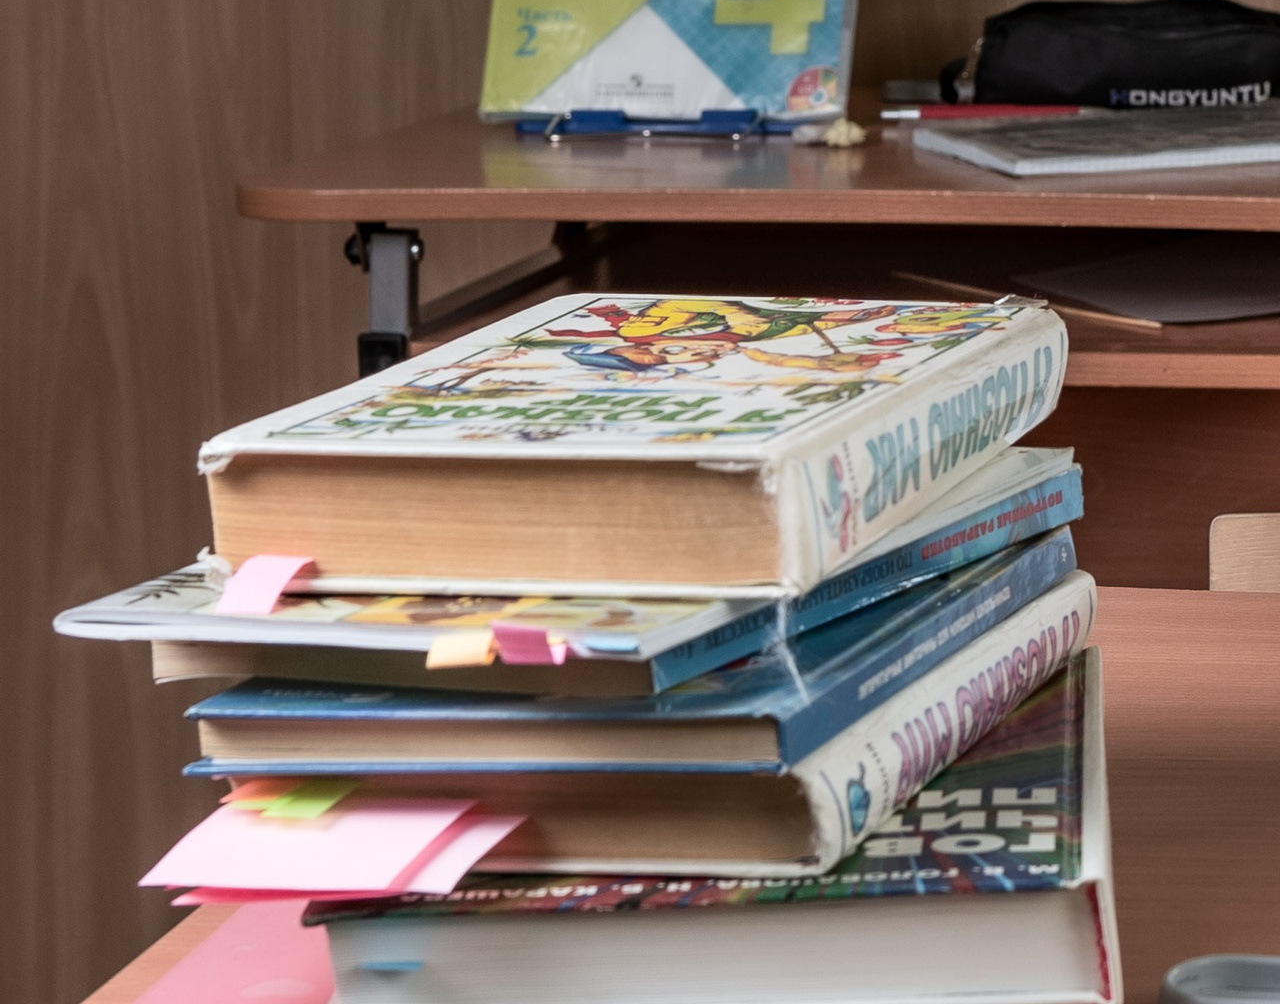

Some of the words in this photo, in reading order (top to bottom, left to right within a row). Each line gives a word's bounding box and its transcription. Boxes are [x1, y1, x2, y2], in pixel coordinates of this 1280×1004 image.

[515, 25, 537, 57] 2
[369, 403, 722, 424] ПОЗНАЮ
[926, 360, 1029, 483] ПОЗНАЮ
[861, 417, 921, 525] МИР
[996, 489, 1063, 530] ПОУРОЧНЫЕ
[921, 511, 994, 562] РАЗРАБОТКИ
